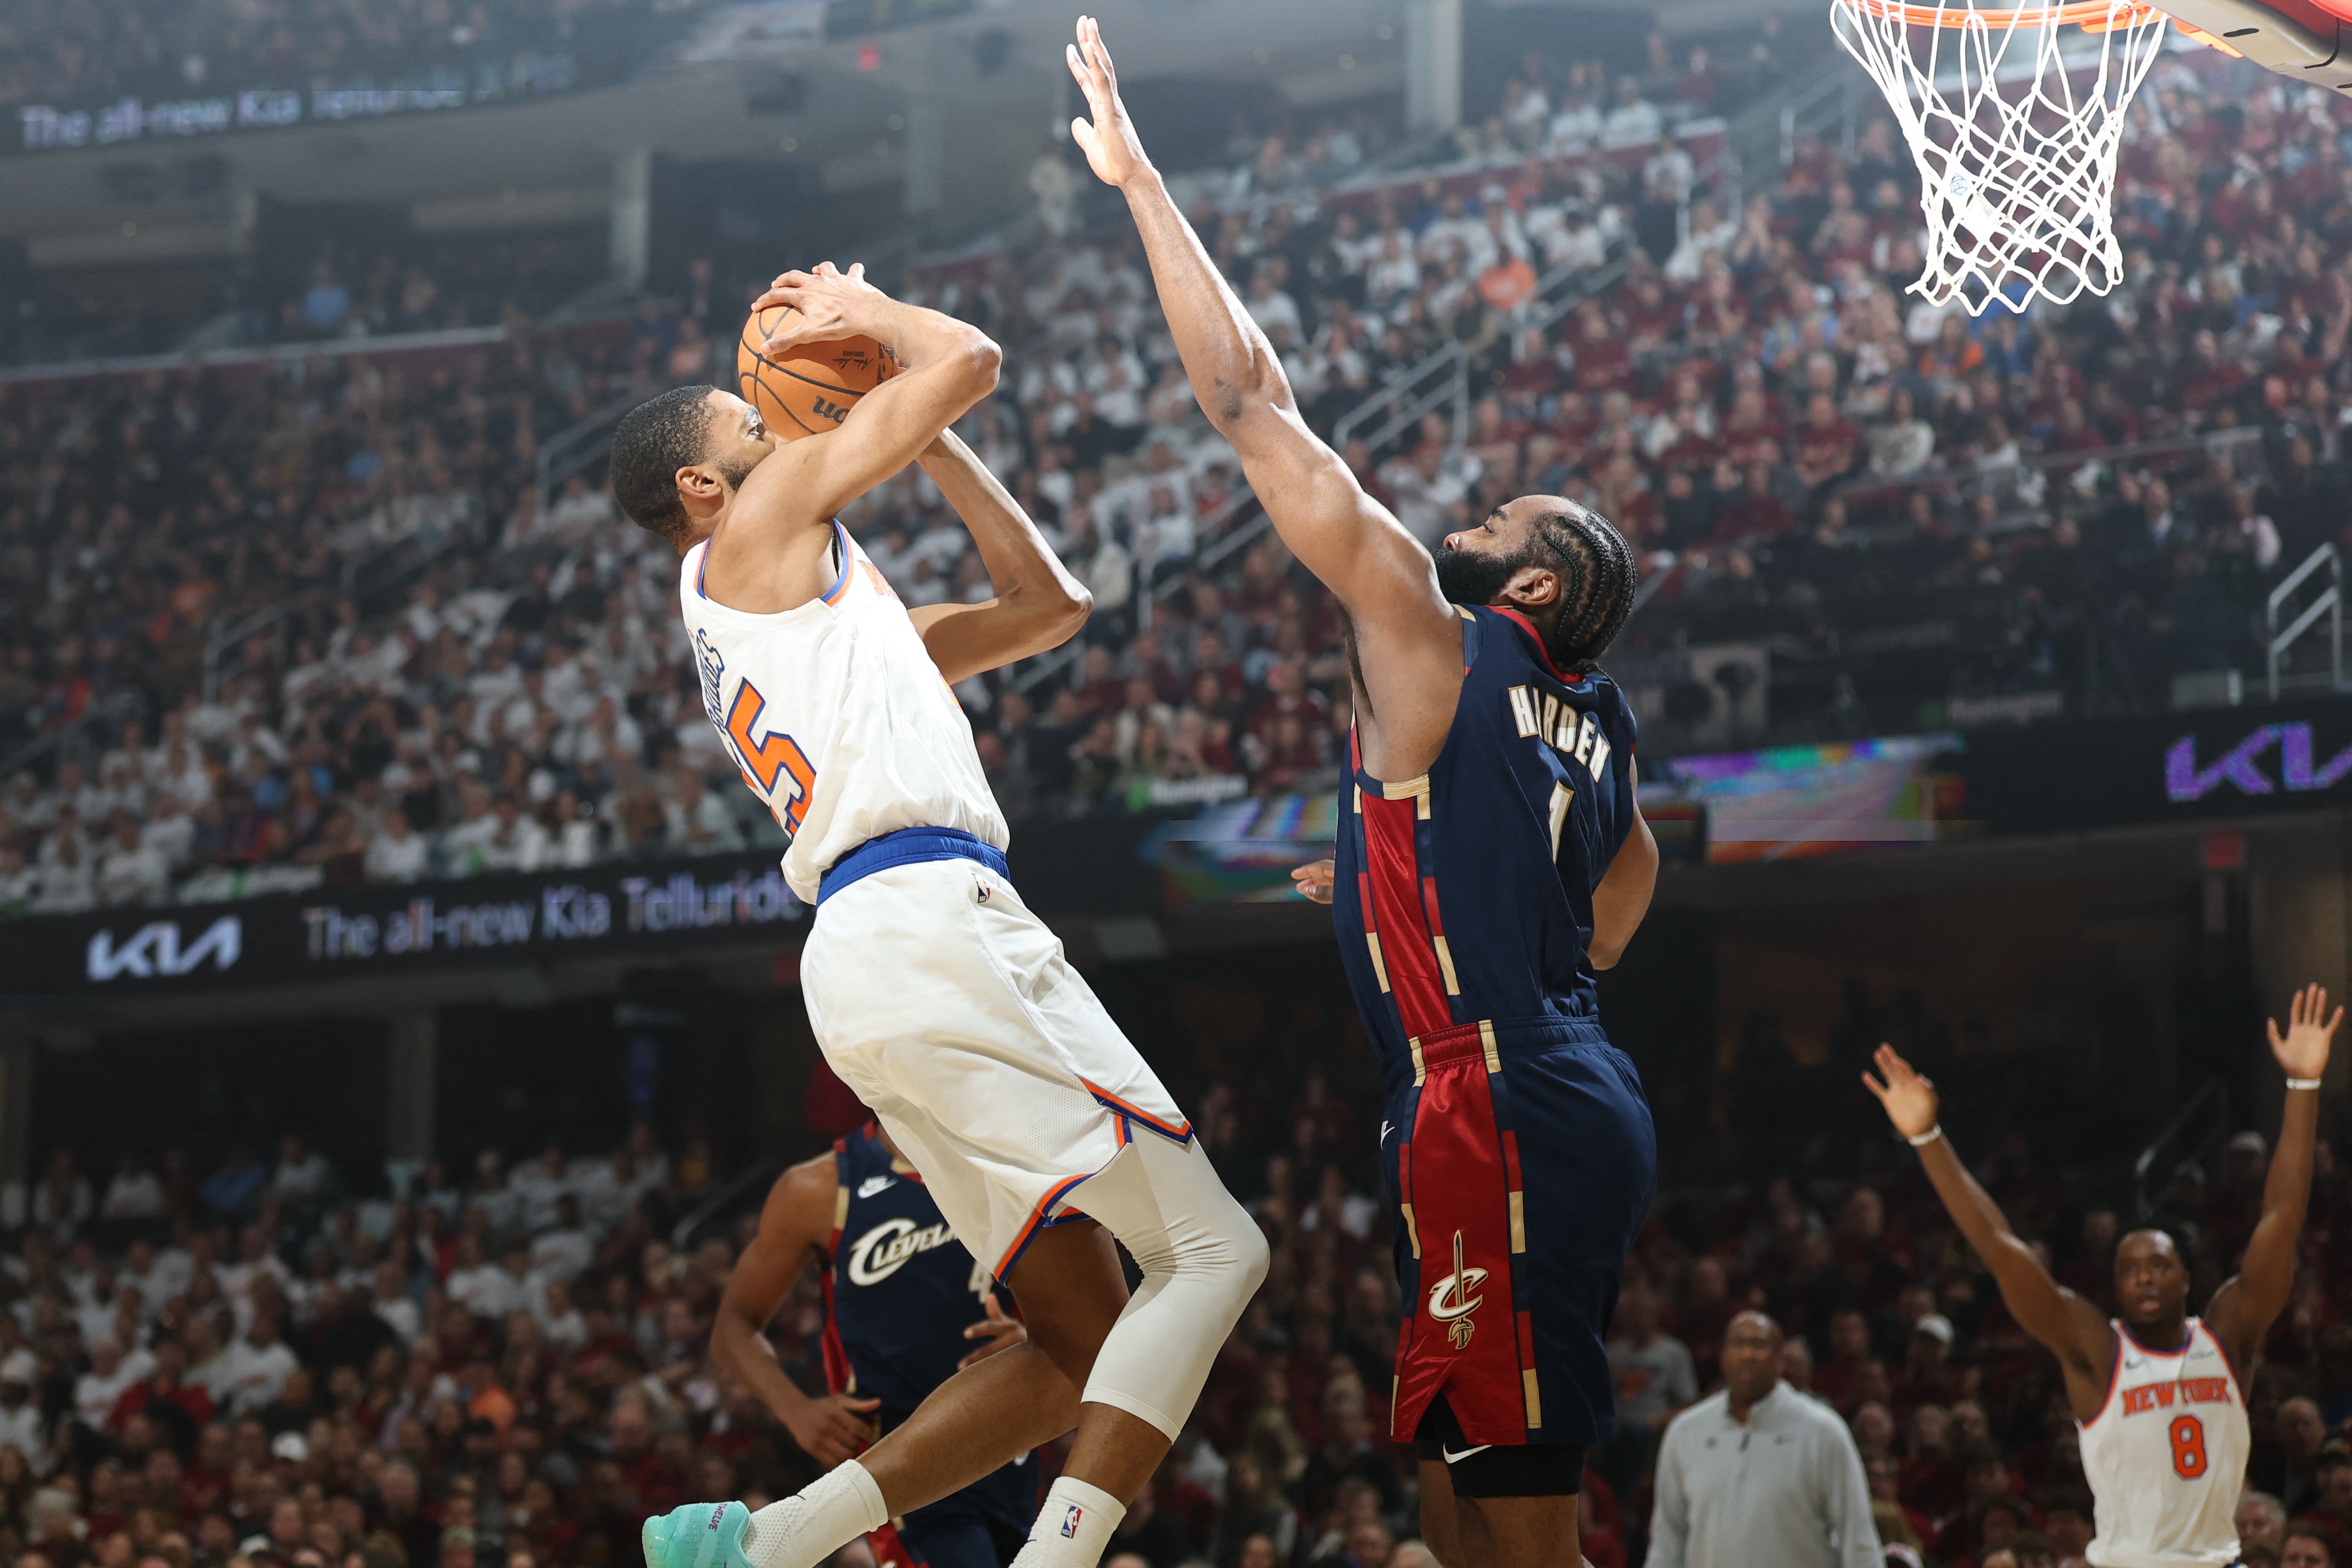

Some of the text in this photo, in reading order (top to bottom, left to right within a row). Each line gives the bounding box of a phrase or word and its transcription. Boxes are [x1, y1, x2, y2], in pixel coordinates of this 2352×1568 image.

[20, 104, 91, 149] The
[98, 97, 232, 143] all-new
[237, 89, 301, 127] Kia
[724, 675, 817, 841] 5
[1549, 780, 1574, 864] 1
[302, 866, 803, 960] The all-new Kia Telluride
[2122, 1382, 2176, 1416] NEW
[2169, 1414, 2208, 1480] 8
[708, 1503, 728, 1532] TWELVE
